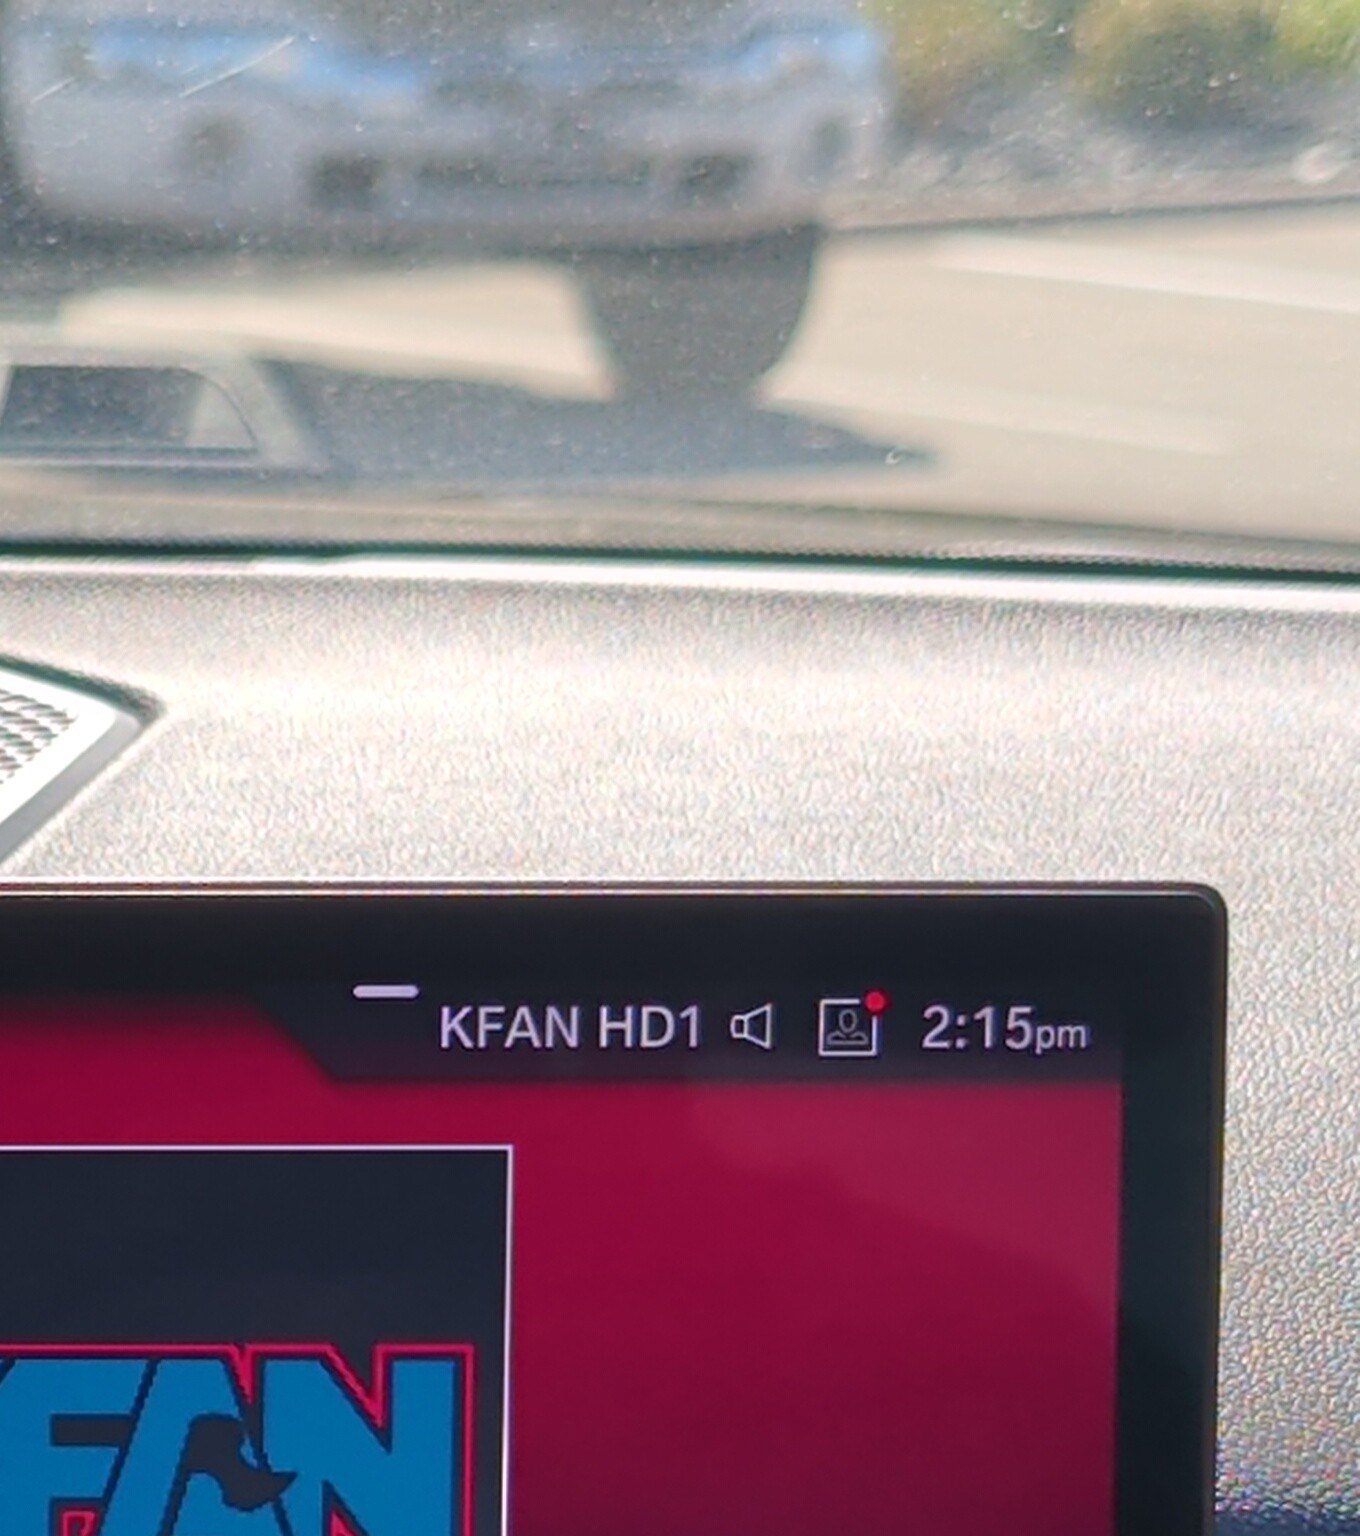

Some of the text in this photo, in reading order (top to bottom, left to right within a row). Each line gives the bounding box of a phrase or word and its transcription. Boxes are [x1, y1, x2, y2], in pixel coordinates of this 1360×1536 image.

[440, 1005, 702, 1050] KFAN HD1
[921, 1005, 1088, 1056] 2:15pm
